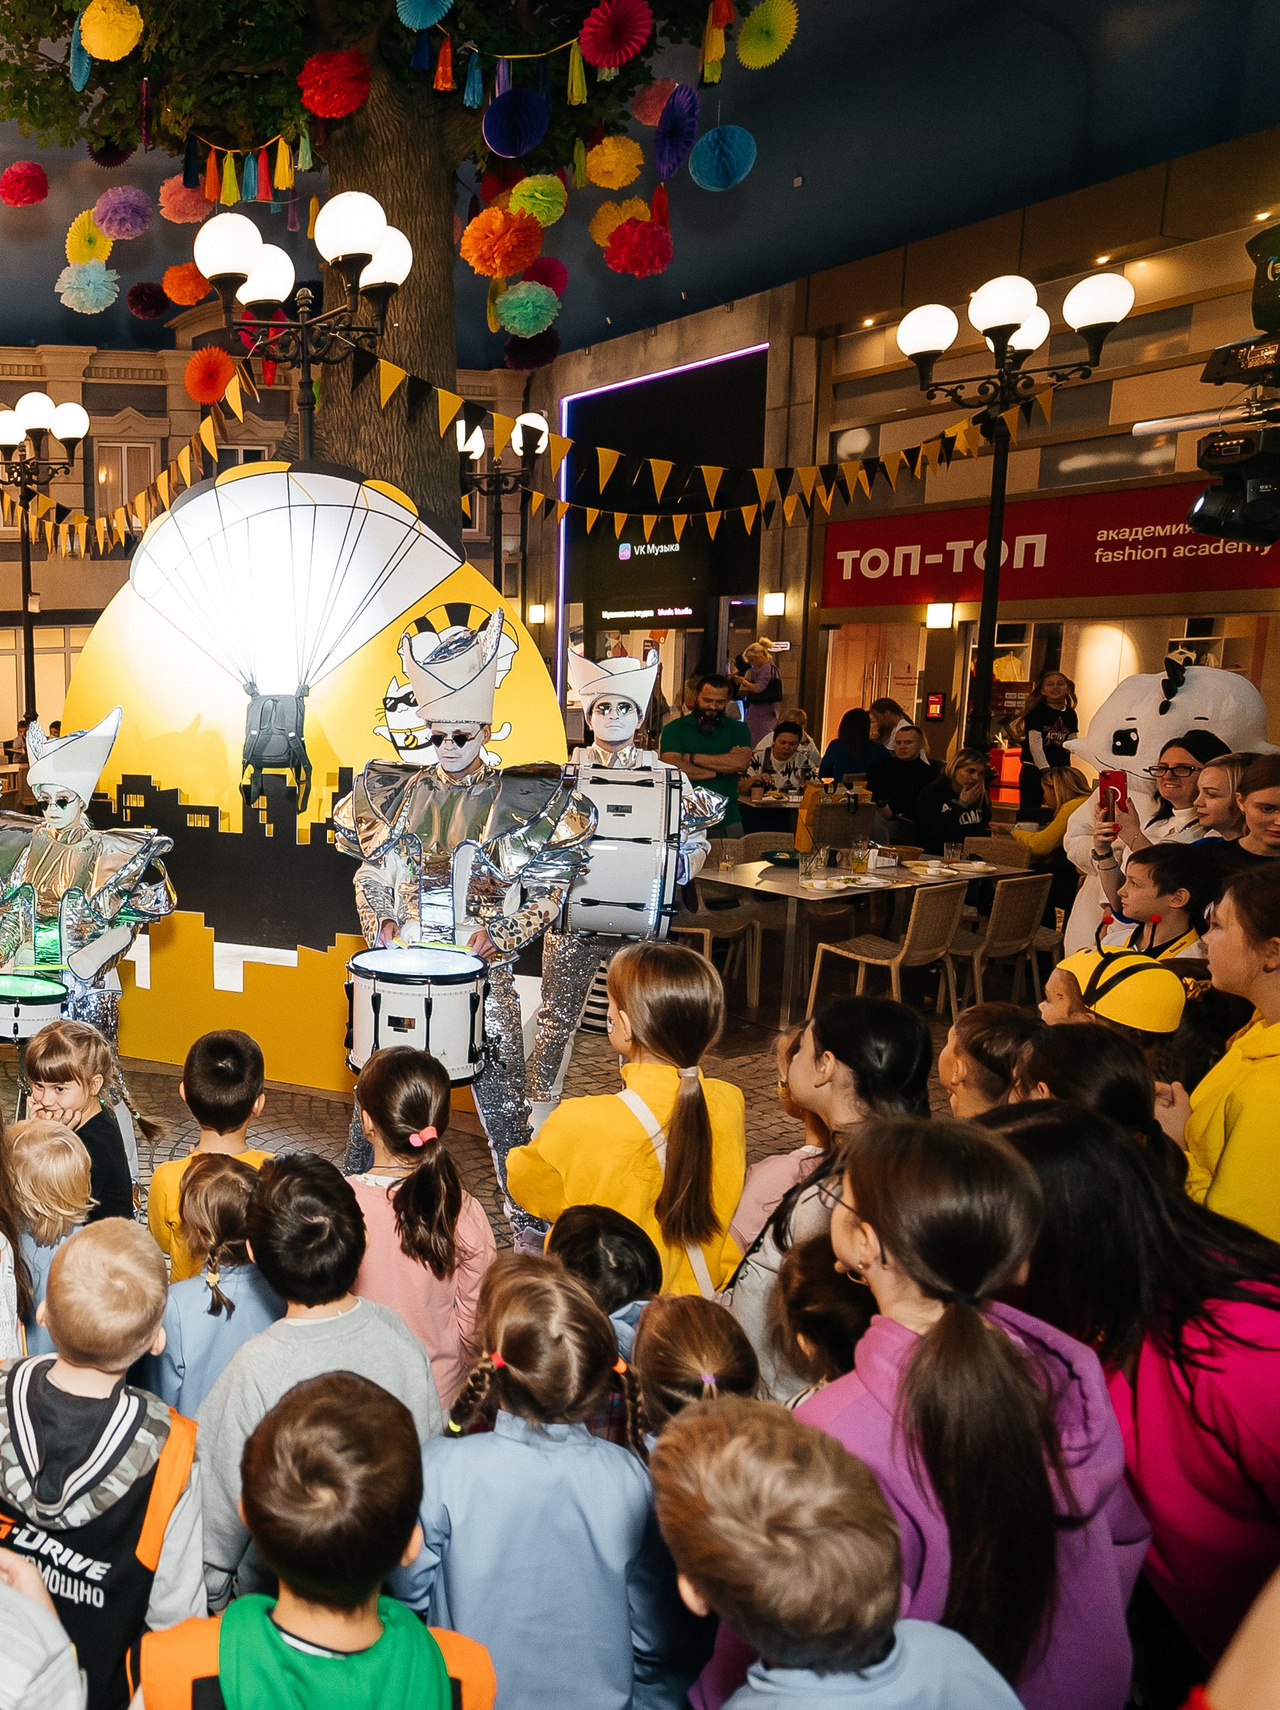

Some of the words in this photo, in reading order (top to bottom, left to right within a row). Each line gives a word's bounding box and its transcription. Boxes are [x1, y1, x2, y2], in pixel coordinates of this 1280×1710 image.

[633, 544, 646, 556] VK
[646, 543, 680, 556] Музыка
[1095, 545, 1167, 563] fashion
